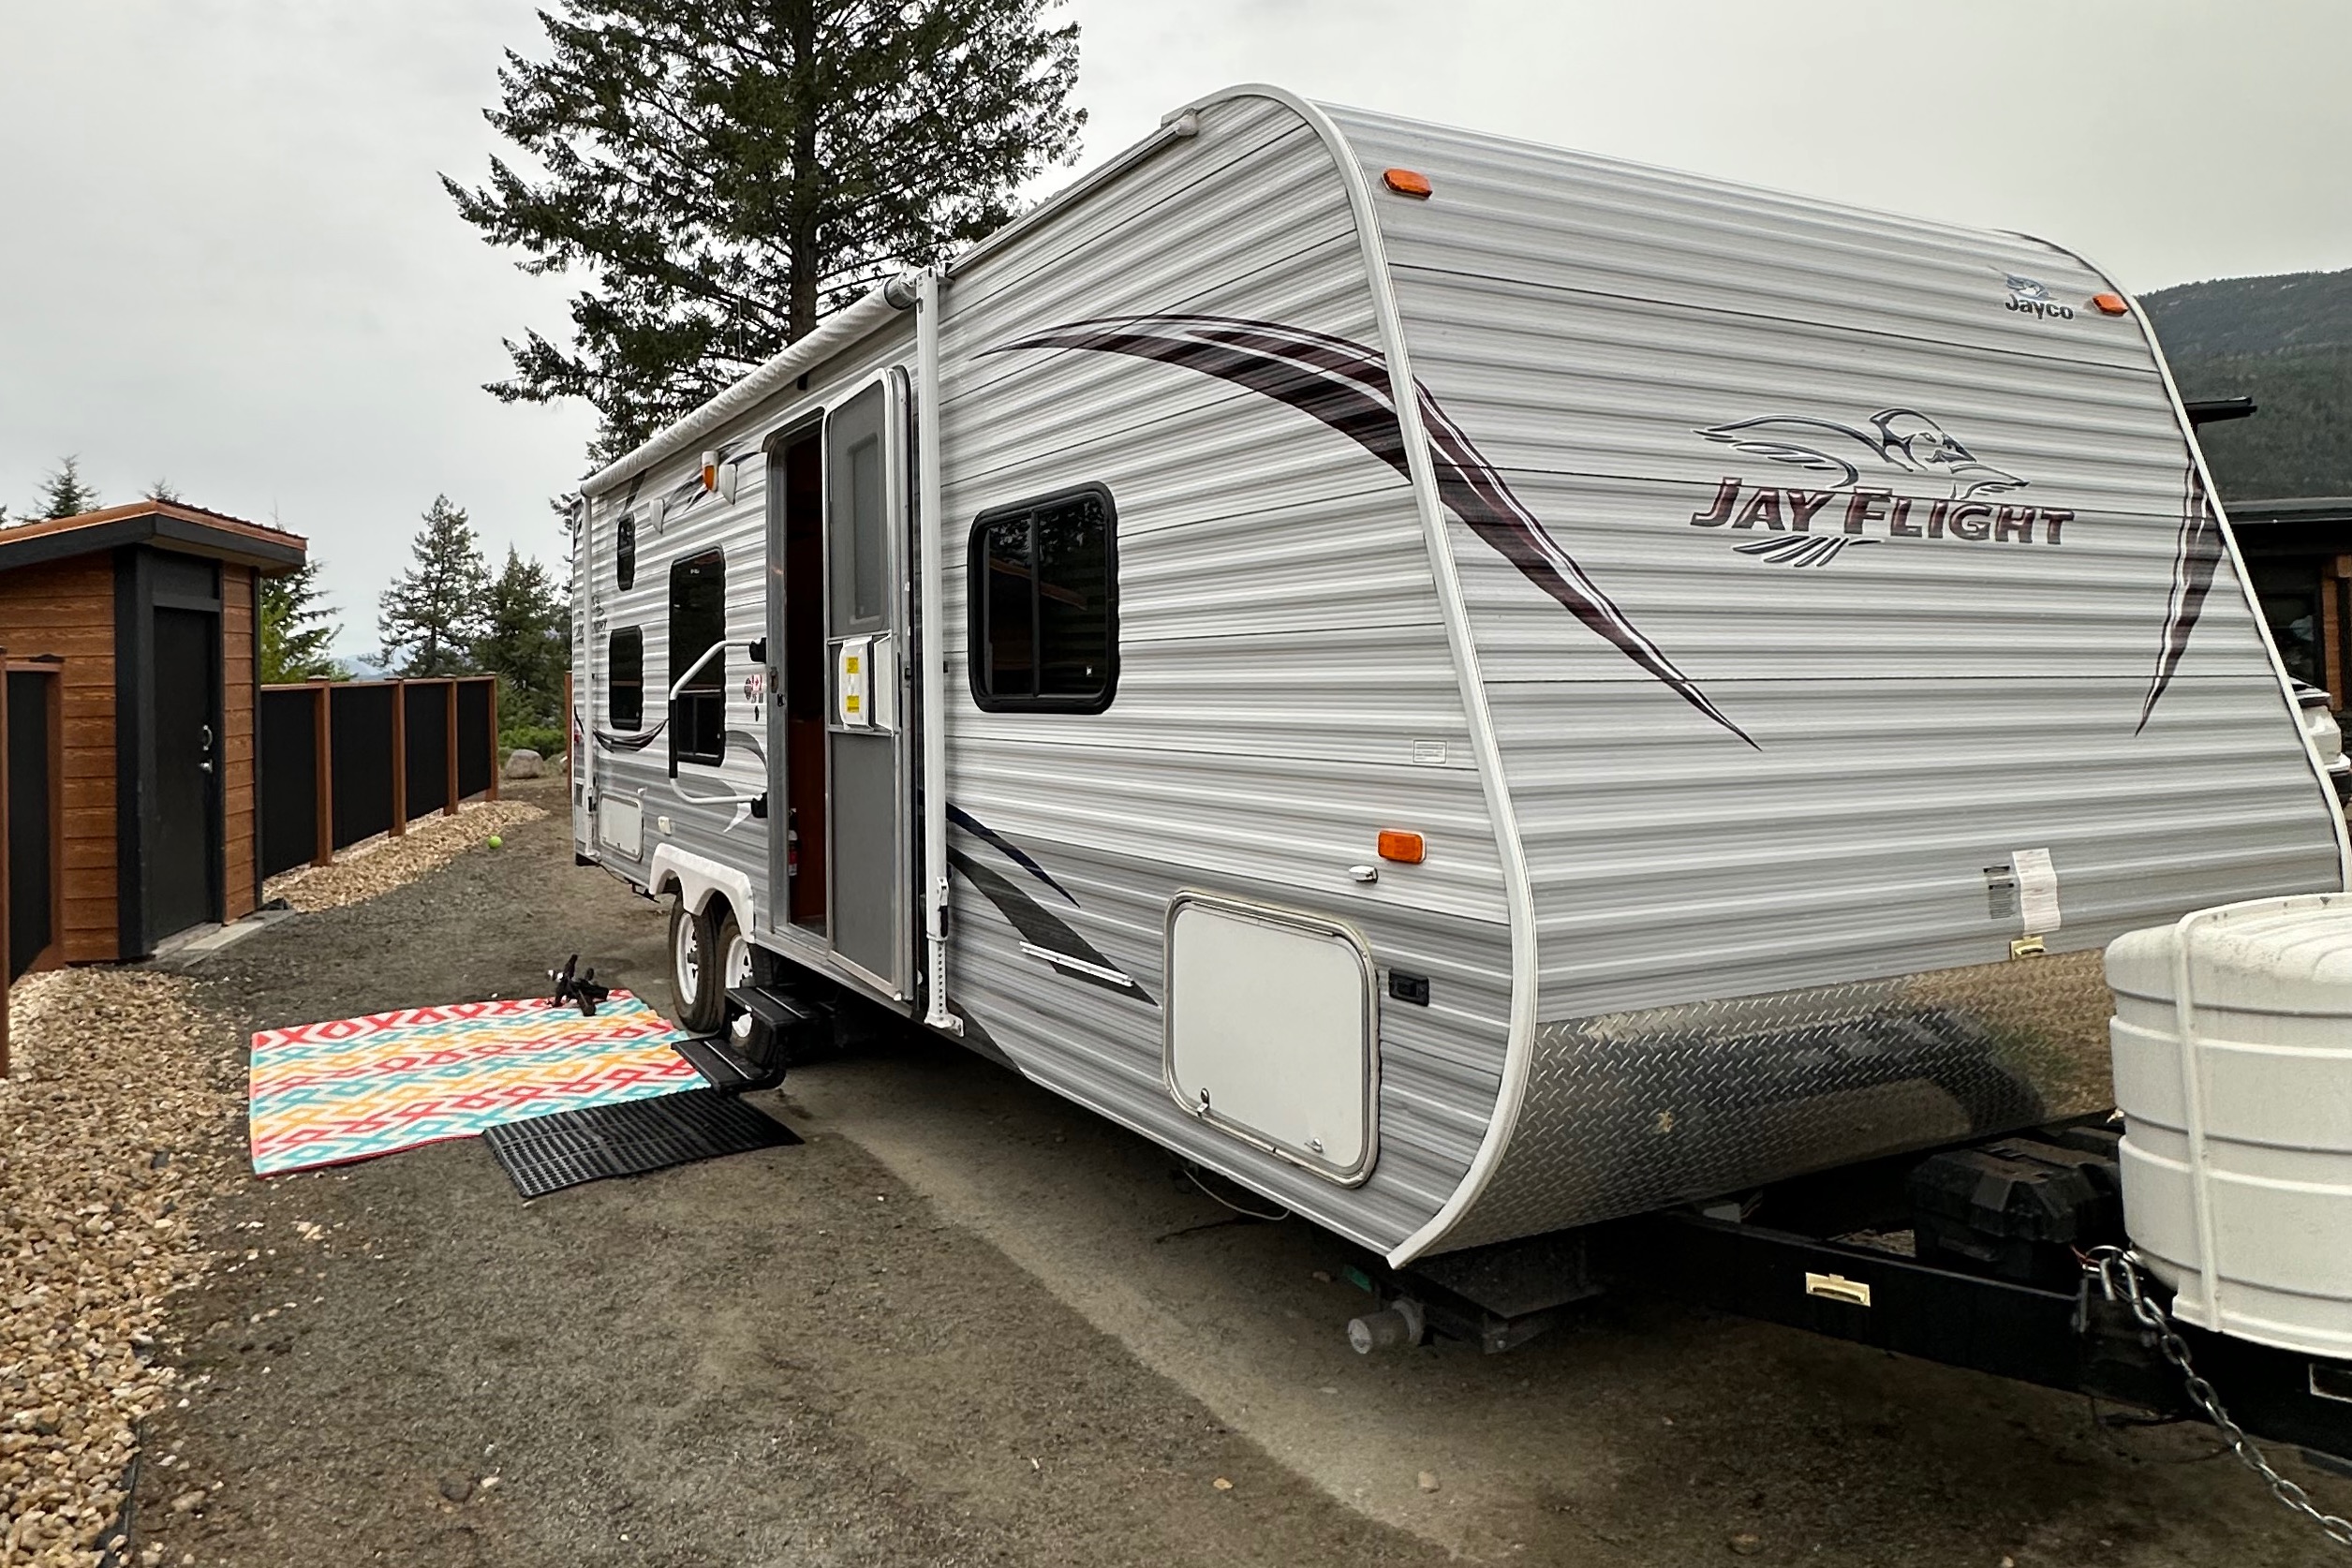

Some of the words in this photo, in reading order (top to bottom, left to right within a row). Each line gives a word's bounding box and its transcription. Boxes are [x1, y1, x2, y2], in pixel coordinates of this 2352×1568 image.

[2004, 293, 2074, 319] Jayco
[1690, 477, 1836, 532] JAY
[1843, 486, 2075, 545] FLIGHT
